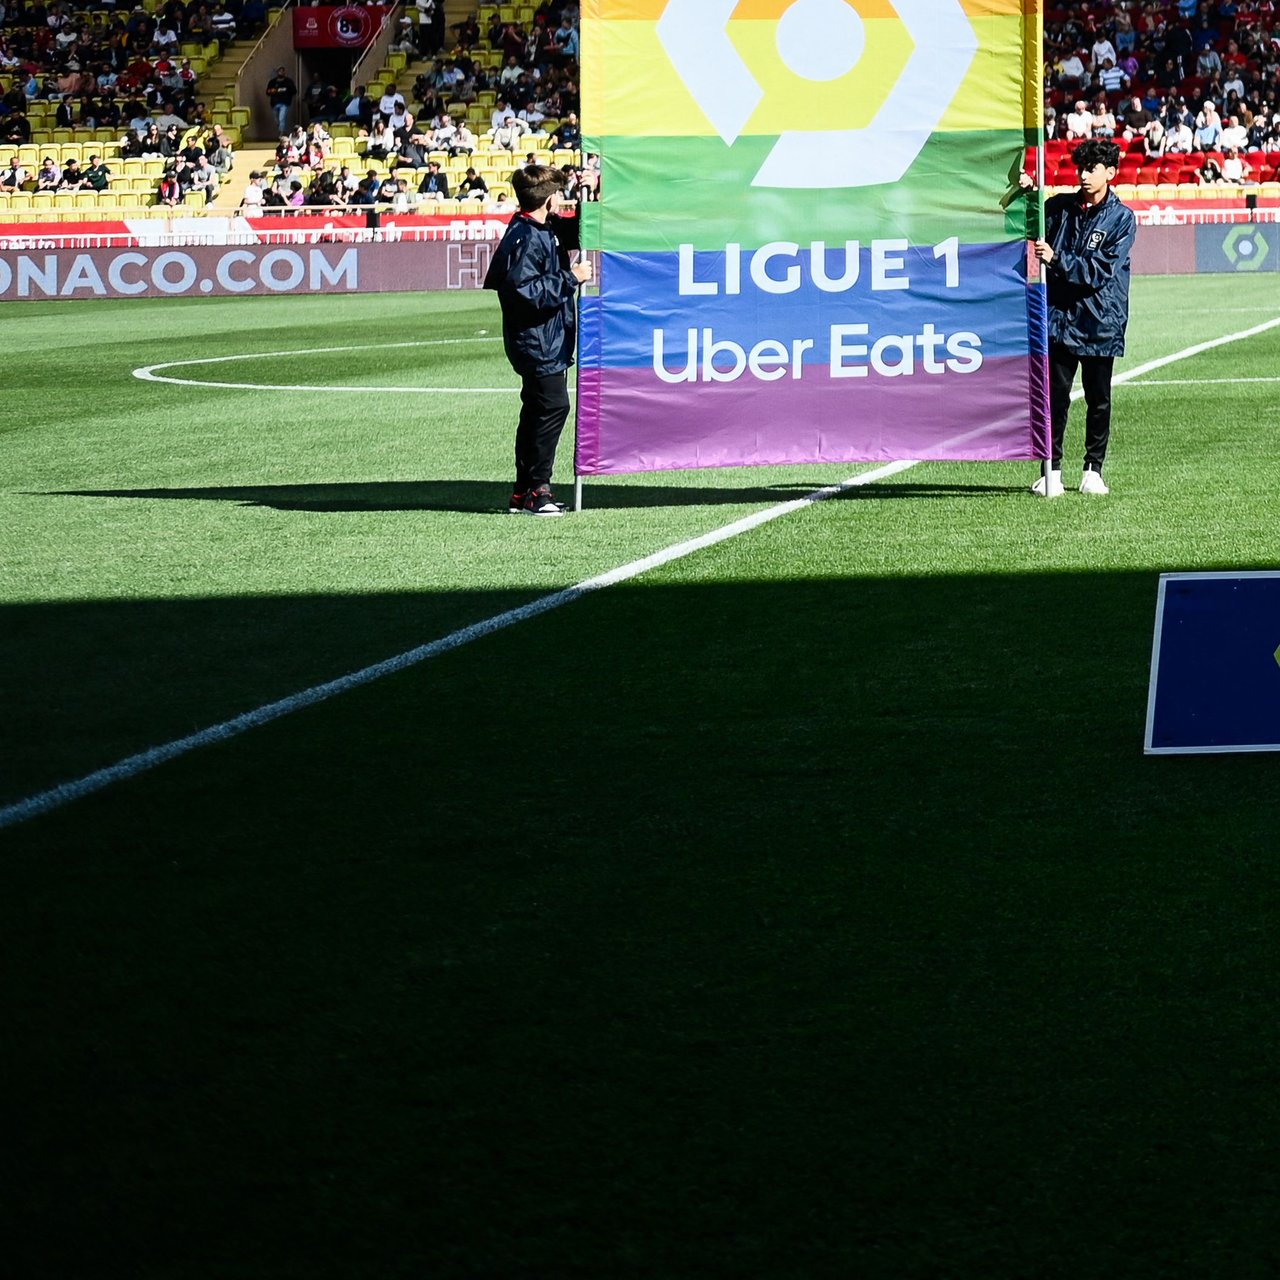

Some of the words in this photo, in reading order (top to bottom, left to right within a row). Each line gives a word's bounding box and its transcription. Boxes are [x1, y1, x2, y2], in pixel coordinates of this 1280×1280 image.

[0, 247, 358, 297] NACO.COM
[678, 237, 910, 296] LIGUE
[934, 236, 961, 289] 1
[652, 325, 814, 384] Uber
[829, 322, 984, 380] Eats
